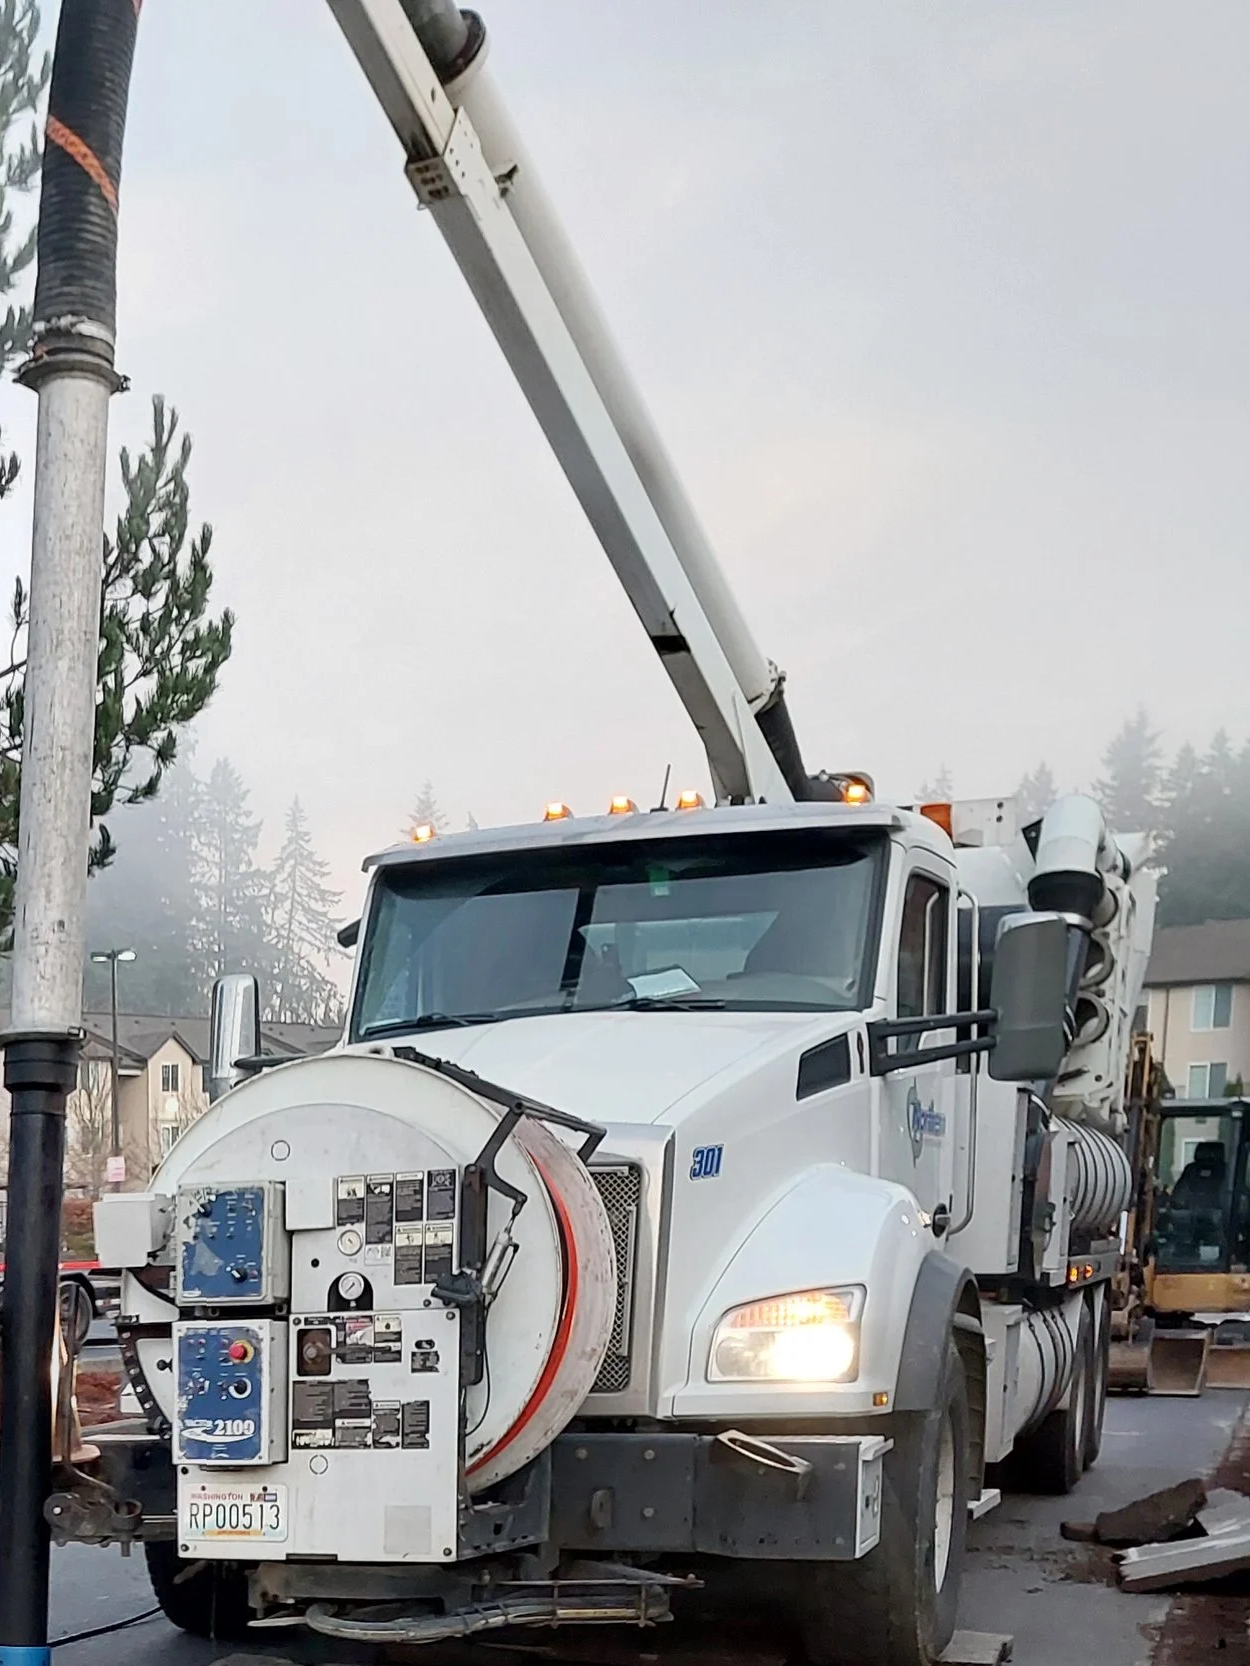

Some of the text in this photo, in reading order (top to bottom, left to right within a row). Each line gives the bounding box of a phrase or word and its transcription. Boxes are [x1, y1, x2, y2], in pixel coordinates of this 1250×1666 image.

[690, 1144, 724, 1181] 301
[214, 1419, 255, 1435] 2100
[190, 1493, 244, 1501] WASHINGTON
[189, 1503, 280, 1530] RP00513
